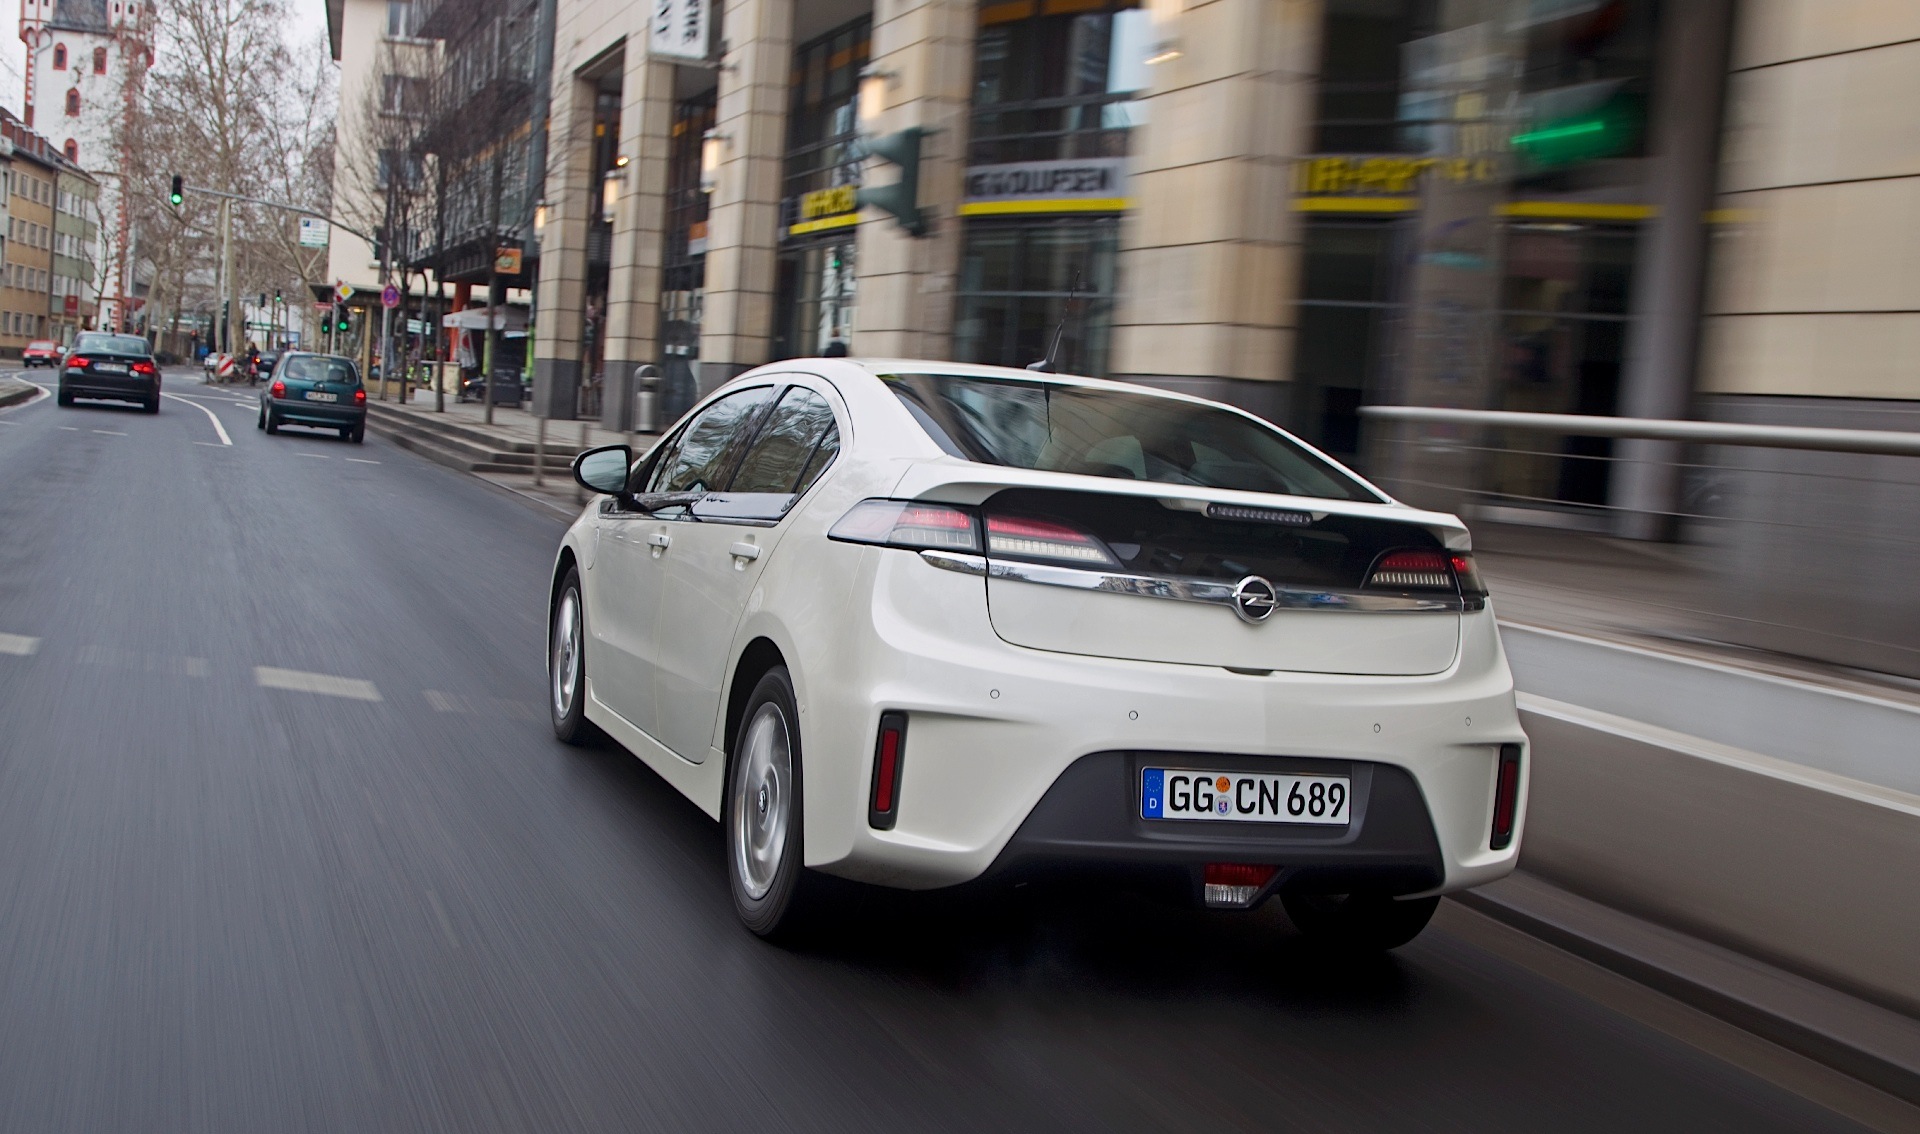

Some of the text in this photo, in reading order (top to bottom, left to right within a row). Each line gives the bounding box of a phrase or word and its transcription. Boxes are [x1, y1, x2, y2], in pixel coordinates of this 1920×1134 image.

[1149, 798, 1157, 809] D
[1169, 775, 1346, 818] GG CN 689
